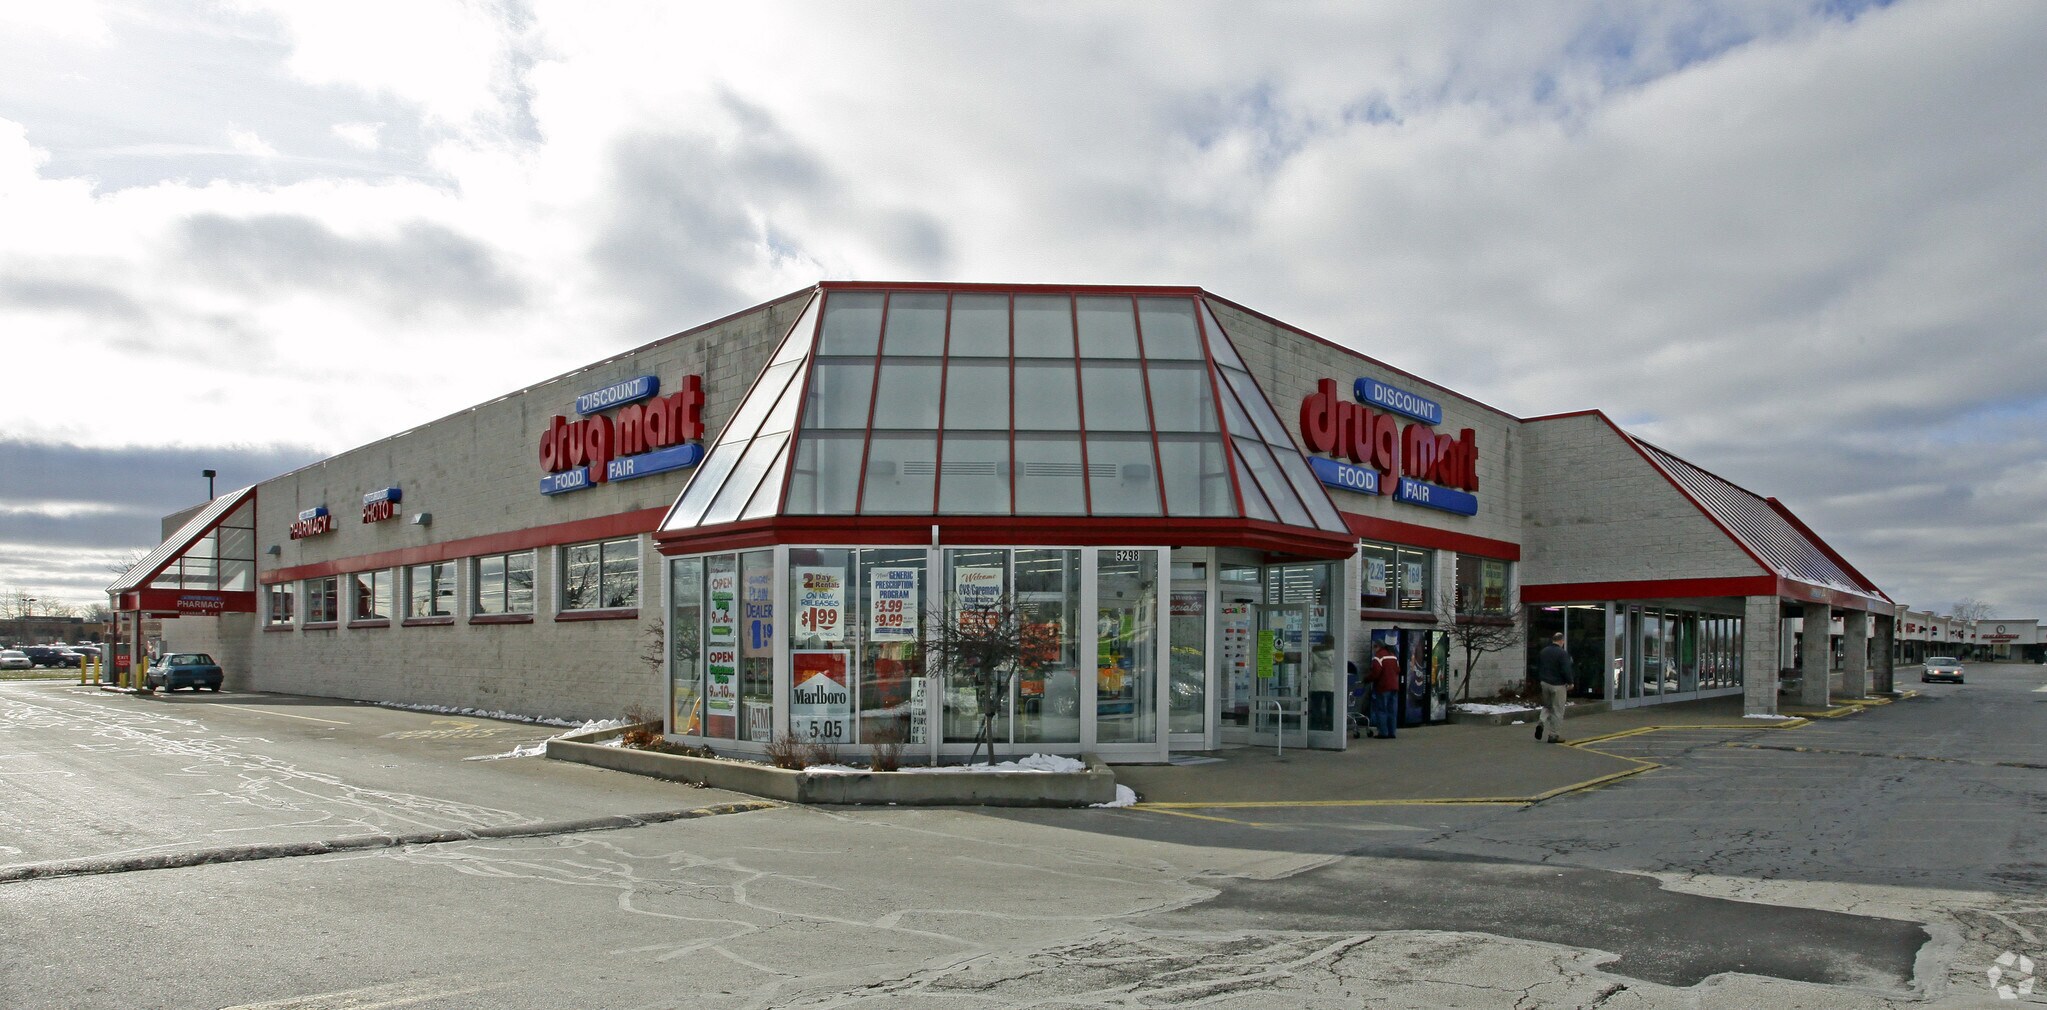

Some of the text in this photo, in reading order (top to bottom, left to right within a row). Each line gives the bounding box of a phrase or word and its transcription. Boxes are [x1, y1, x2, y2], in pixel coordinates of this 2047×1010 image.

[582, 380, 641, 411] DISCOUNT
[1374, 384, 1434, 419] DISCOUNT
[539, 375, 705, 482] drug mart
[1300, 378, 1479, 496] drug mart
[555, 459, 634, 489] FOOD FAIR
[1338, 466, 1430, 502] FOOD FAIR
[362, 500, 391, 523] PHOTO
[290, 515, 330, 540] PHARMACY
[1116, 550, 1139, 561] 5298
[803, 573, 831, 588] 2 Day
[889, 571, 913, 580] GENERIC
[962, 573, 998, 582] Welcome
[712, 577, 733, 590] OPEN
[876, 581, 914, 589] PRESCRIPTION
[806, 592, 817, 600] ON
[880, 590, 910, 599] PROGRAM
[177, 600, 225, 609] PHARMACY
[746, 603, 773, 618] DEALER
[875, 600, 903, 613] $3.99
[1170, 601, 1202, 612] ecials
[875, 614, 903, 627] $9.99
[709, 652, 734, 663] OPEN
[793, 685, 847, 704] Marlboro
[752, 708, 769, 729] ATM
[809, 721, 842, 738] 5.05
